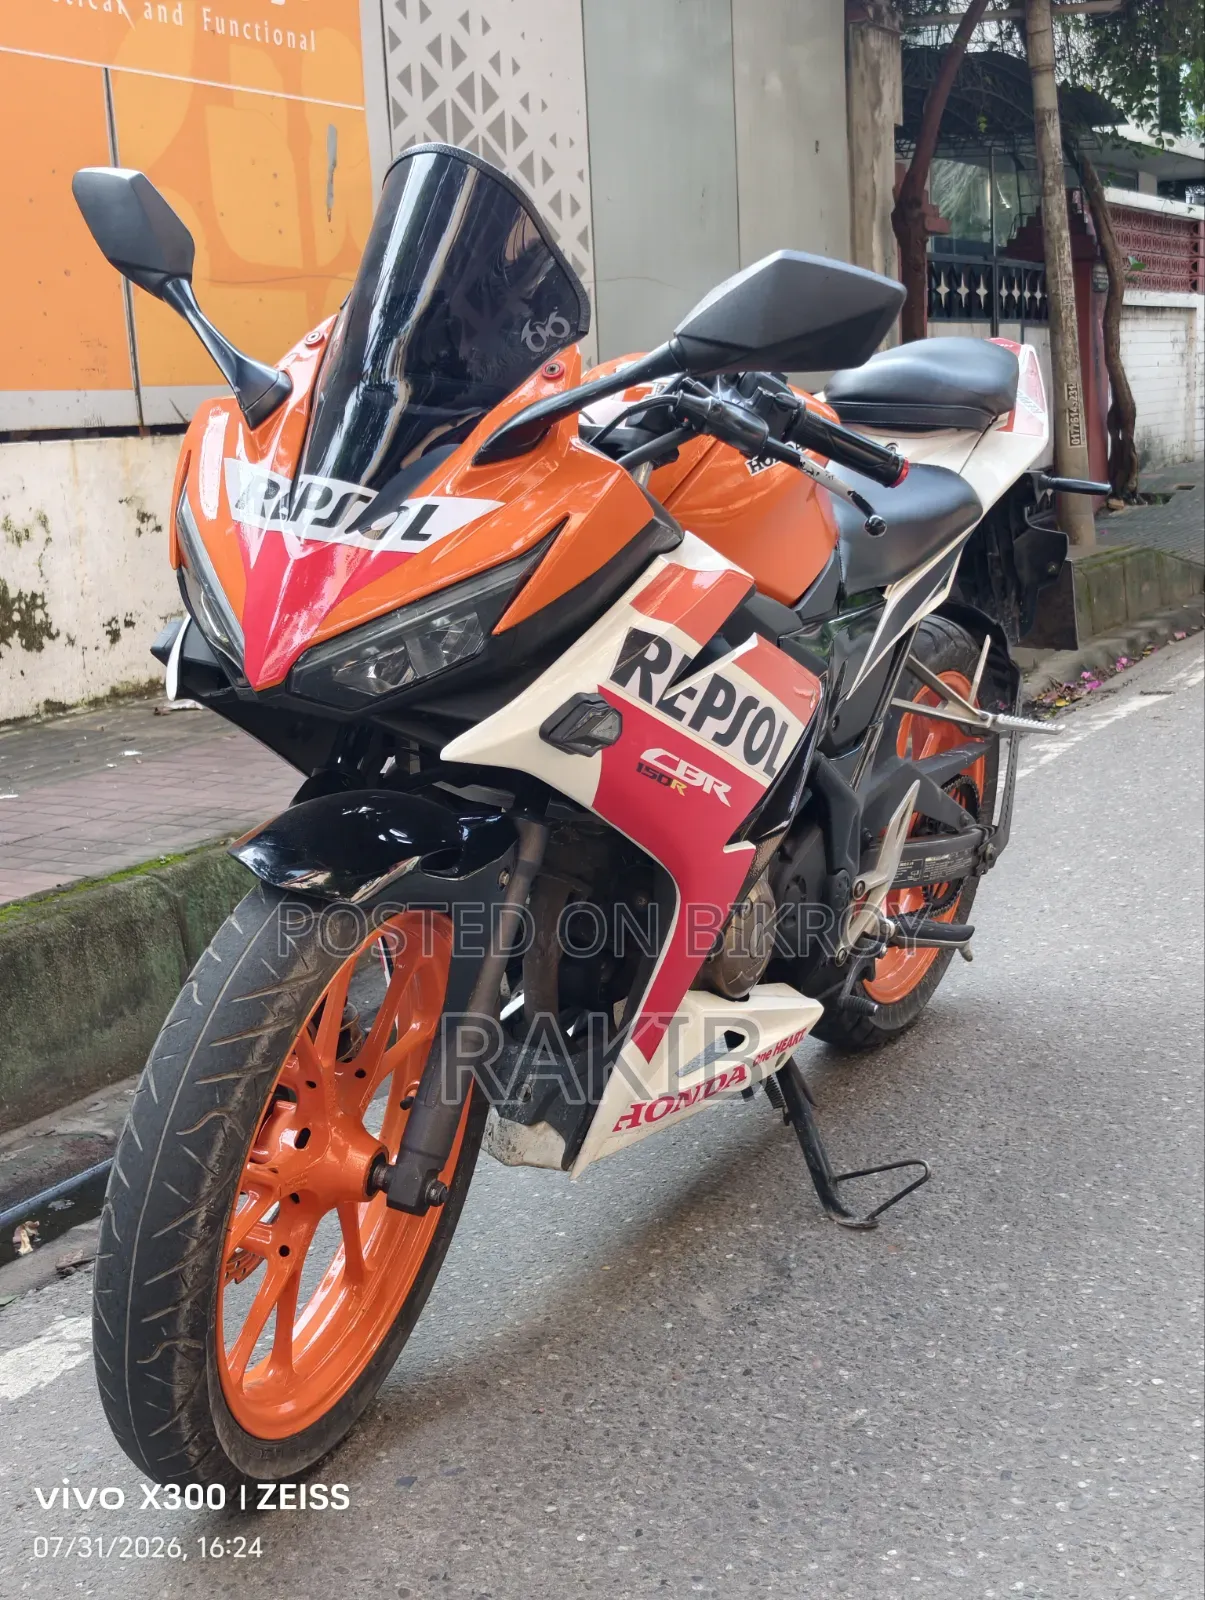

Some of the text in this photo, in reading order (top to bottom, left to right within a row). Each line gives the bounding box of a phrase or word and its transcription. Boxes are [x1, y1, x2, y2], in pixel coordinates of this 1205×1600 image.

[143, 2, 184, 27] and
[202, 7, 316, 52] Functional
[609, 626, 789, 779] REPSOL
[636, 762, 687, 796] 150R
[640, 748, 732, 807] CBR
[612, 1064, 747, 1132] HONDA
